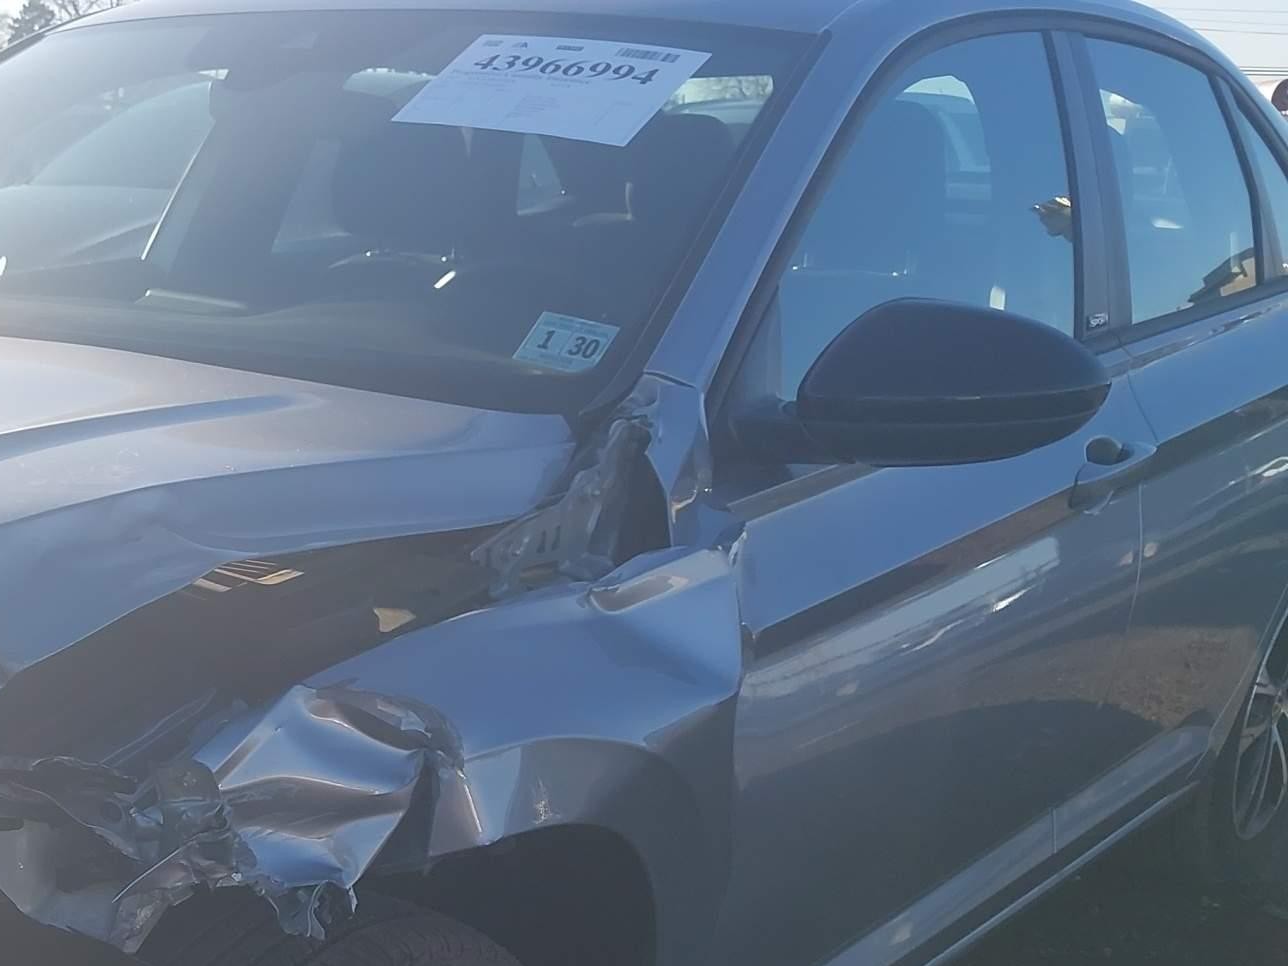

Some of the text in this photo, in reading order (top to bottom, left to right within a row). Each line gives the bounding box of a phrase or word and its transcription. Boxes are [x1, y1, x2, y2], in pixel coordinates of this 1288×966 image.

[472, 53, 661, 85] 43966994
[536, 330, 601, 359] 1 30
